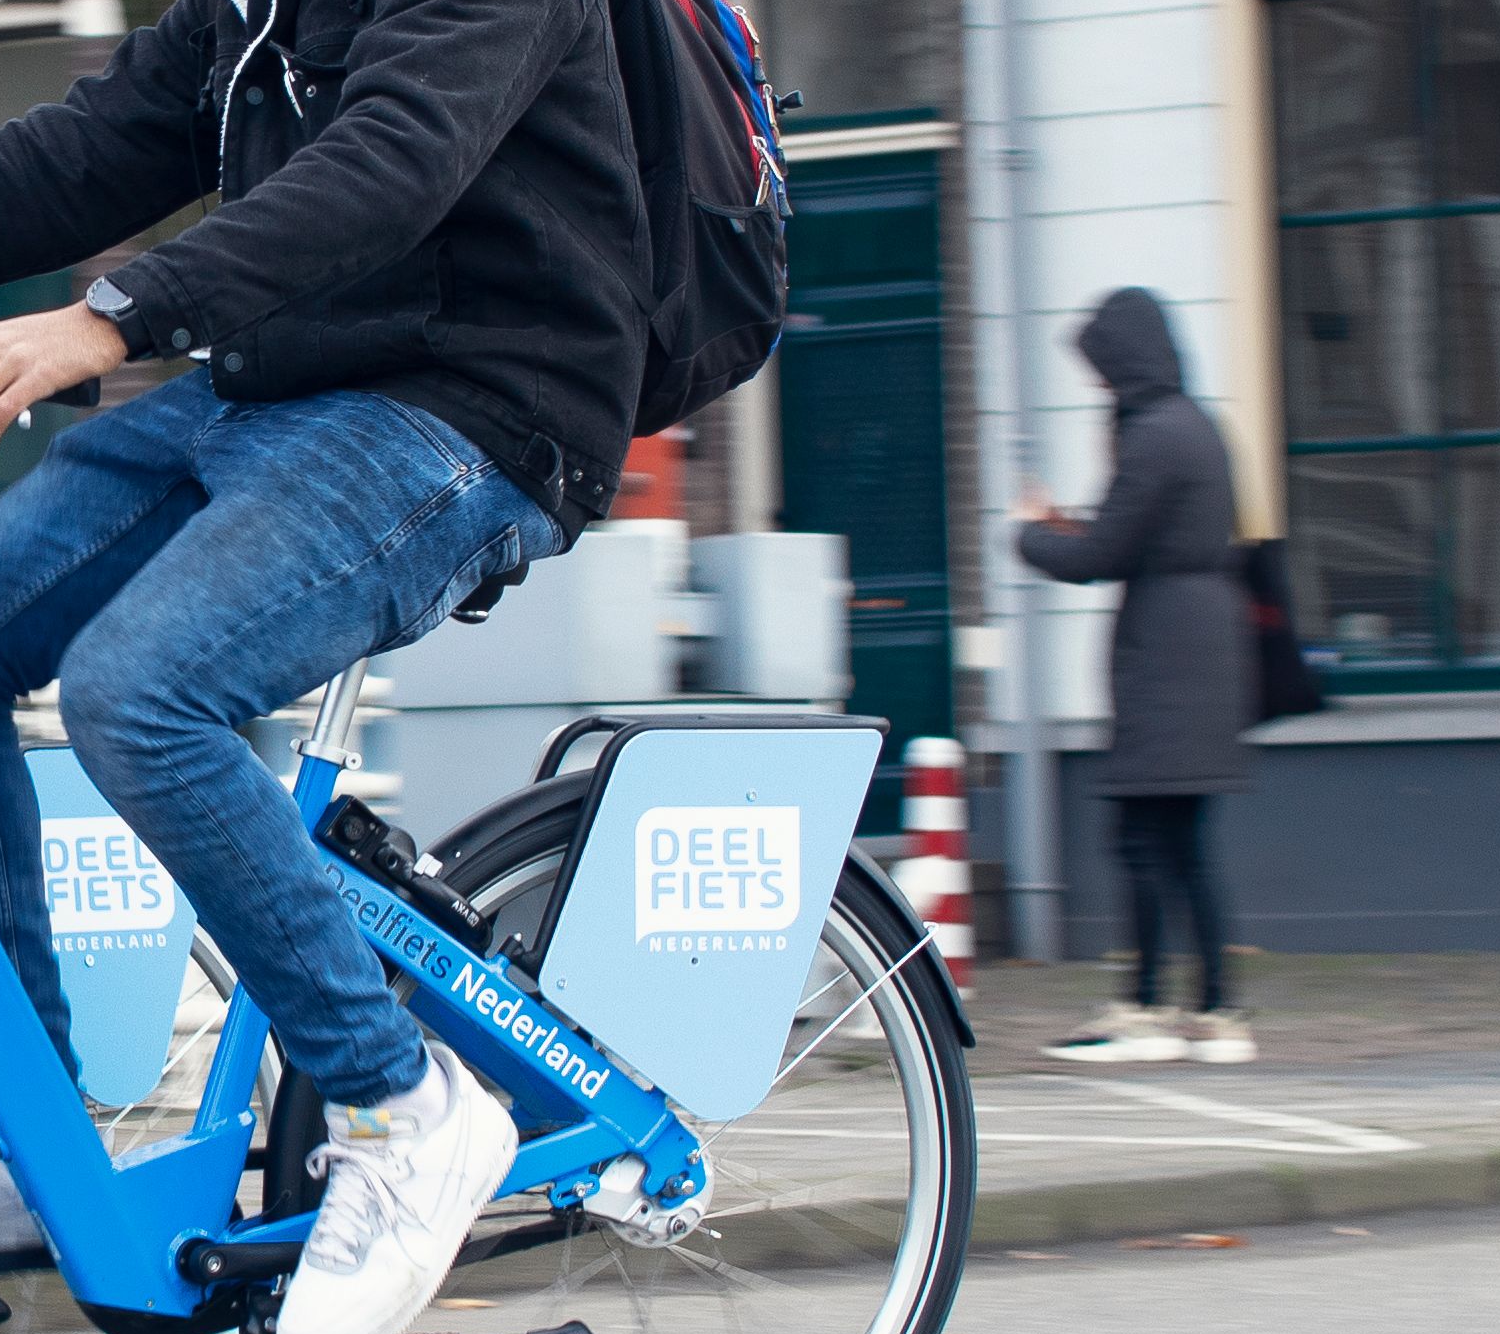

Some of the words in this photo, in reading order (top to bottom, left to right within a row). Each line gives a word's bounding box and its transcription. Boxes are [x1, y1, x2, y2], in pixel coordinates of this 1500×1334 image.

[44, 835, 156, 872] DEEL
[650, 827, 782, 866] DEEL
[47, 874, 162, 913] FIETS
[451, 899, 469, 919] AXA
[648, 871, 785, 910] FIETS
[51, 933, 167, 953] NEDERLAND
[649, 935, 788, 952] NEDERLAND
[450, 962, 610, 1099] Nederland
